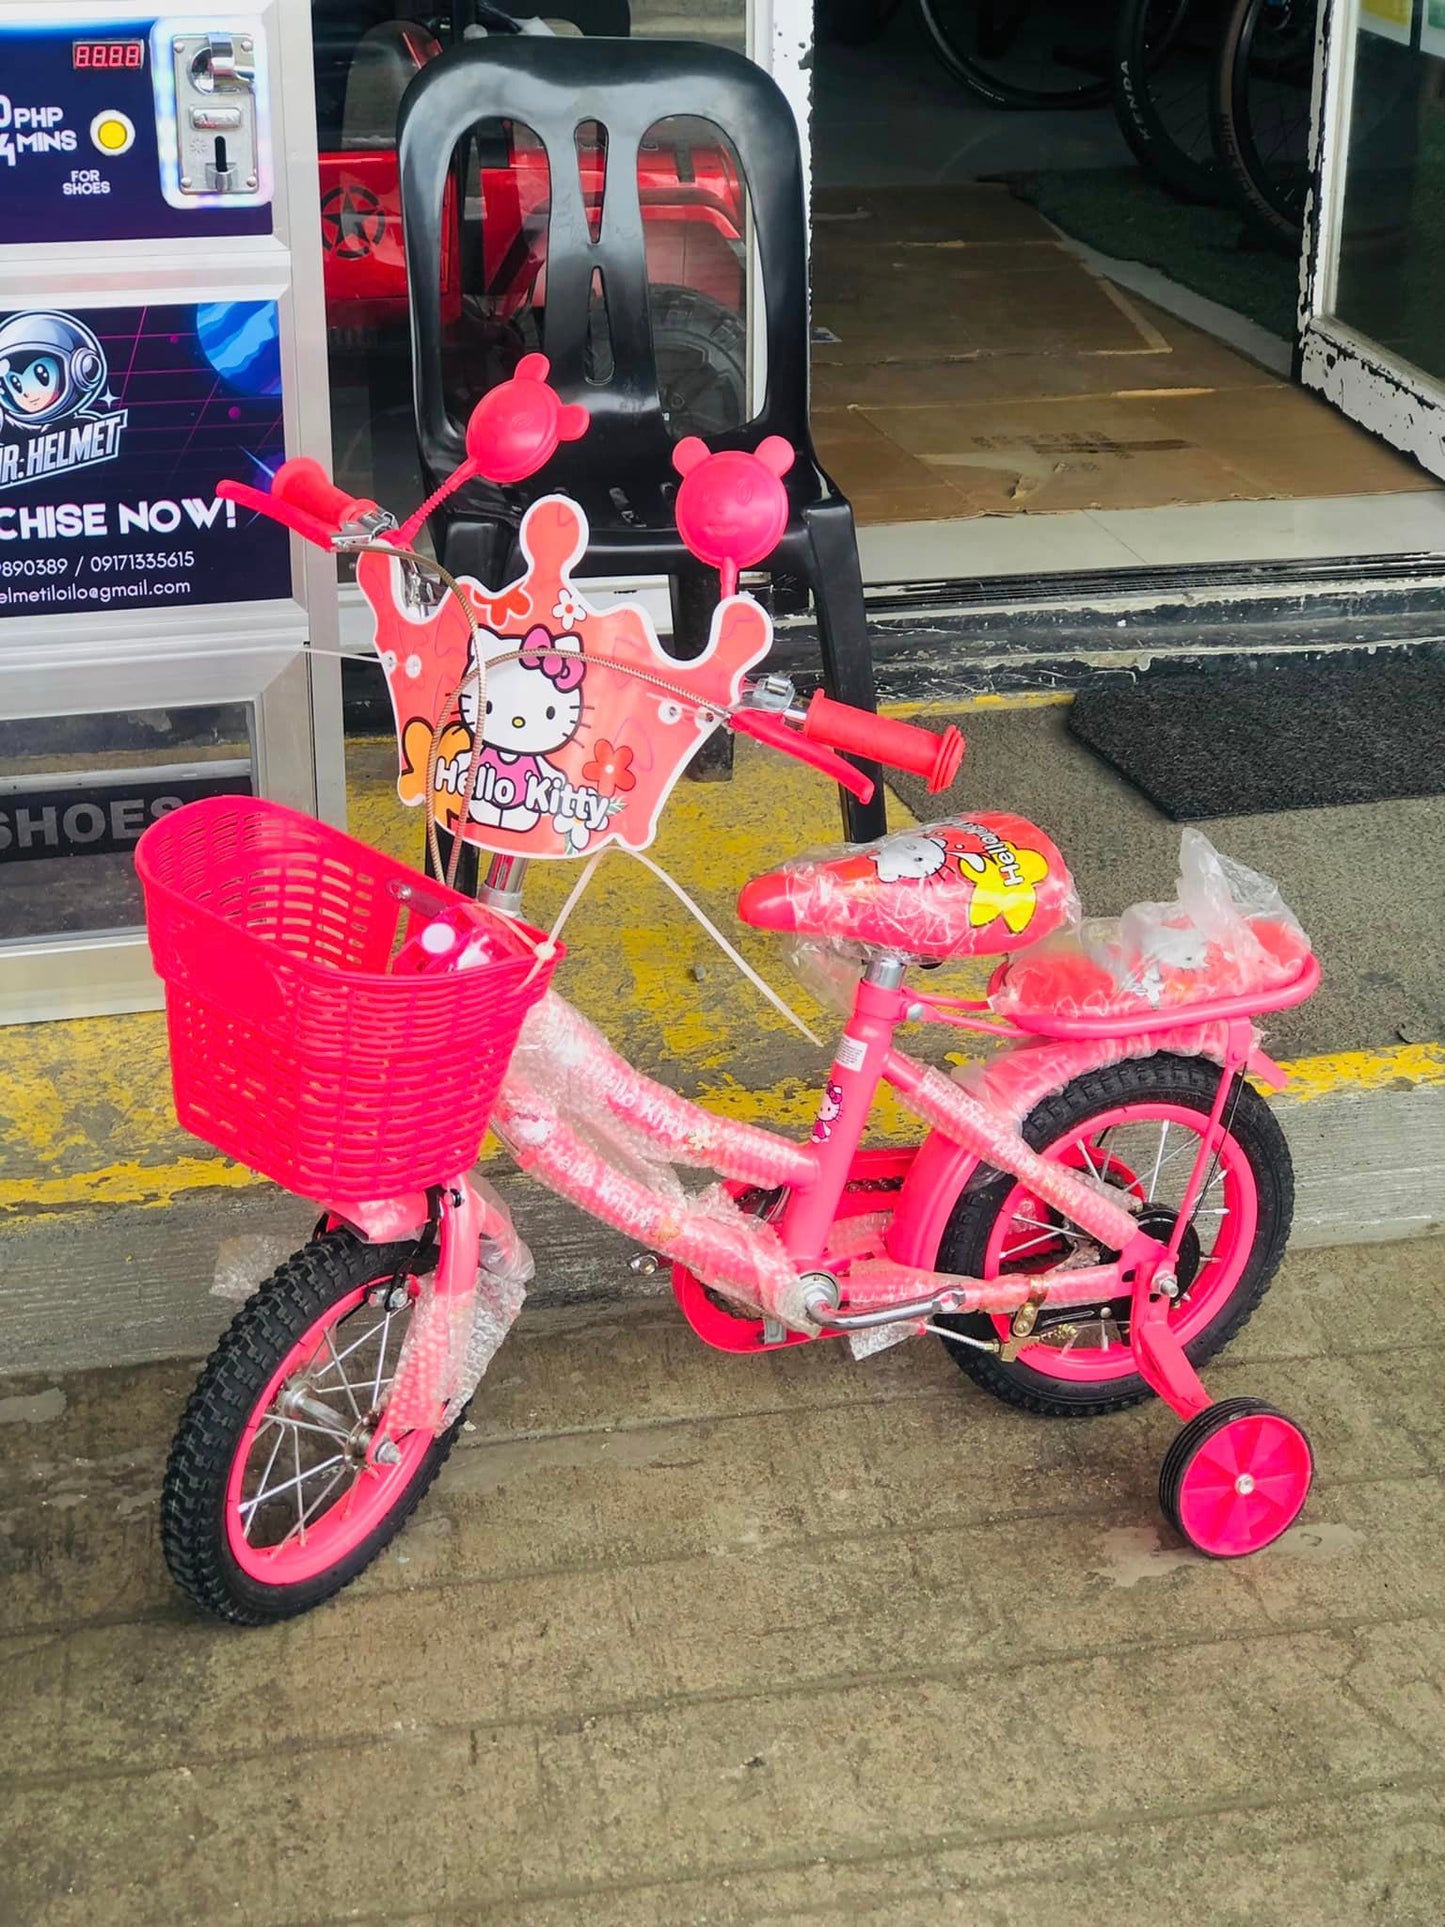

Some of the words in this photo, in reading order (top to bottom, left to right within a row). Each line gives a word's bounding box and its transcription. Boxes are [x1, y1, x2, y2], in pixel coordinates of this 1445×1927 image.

[62, 181, 111, 195] SHOES
[71, 169, 100, 182] FOR
[26, 415, 121, 477] HELMET
[119, 496, 237, 535] NOW!
[90, 551, 195, 573] 09171335615
[525, 772, 610, 830] Kitty
[979, 835, 1025, 887] Hello
